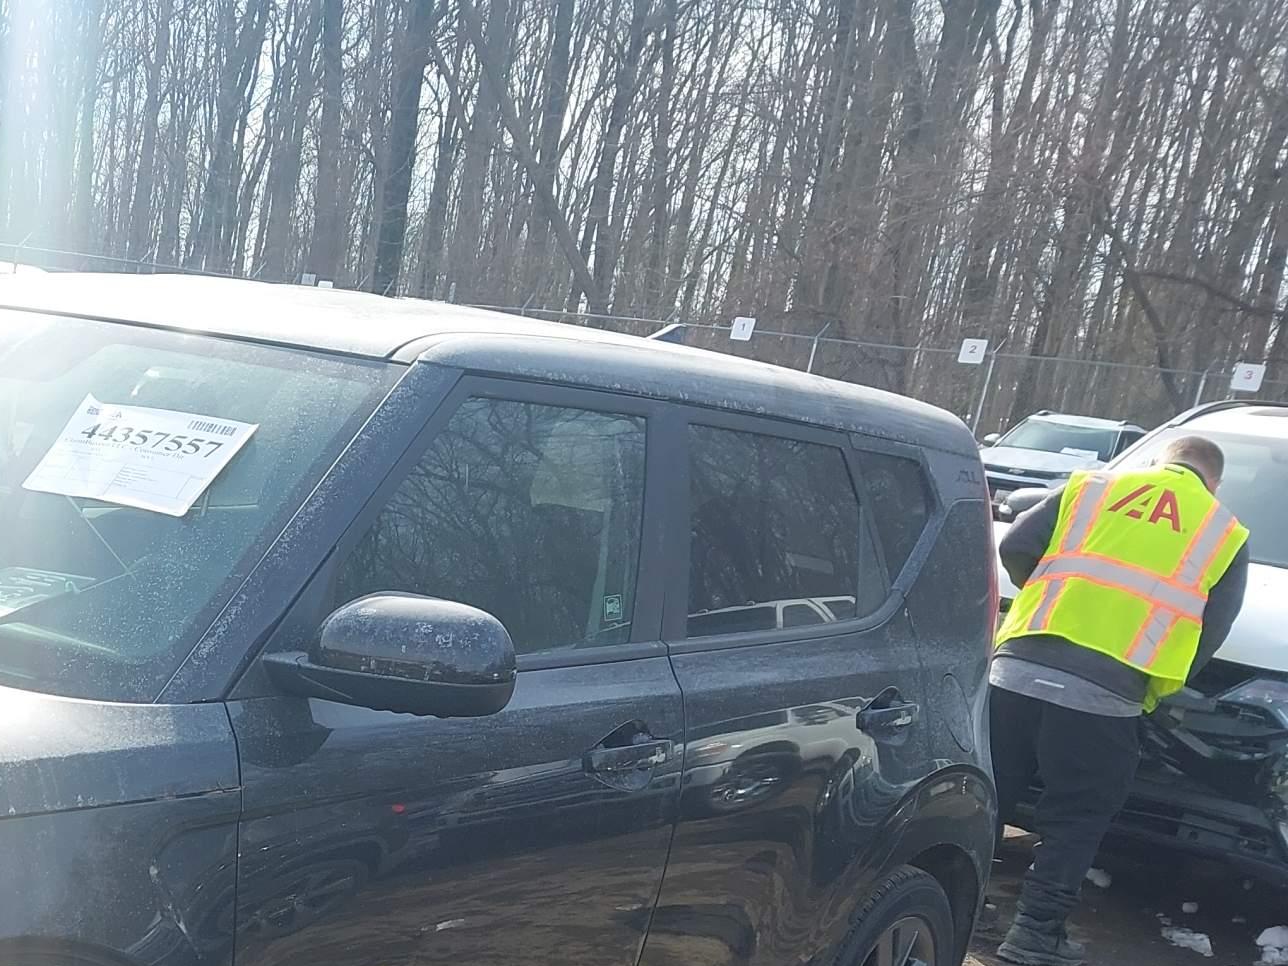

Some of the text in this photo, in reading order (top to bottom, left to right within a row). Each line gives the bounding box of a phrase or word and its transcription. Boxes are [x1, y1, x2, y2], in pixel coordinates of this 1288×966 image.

[968, 344, 977, 354] 2
[1243, 370, 1254, 380] 3
[80, 423, 224, 458] 44357557
